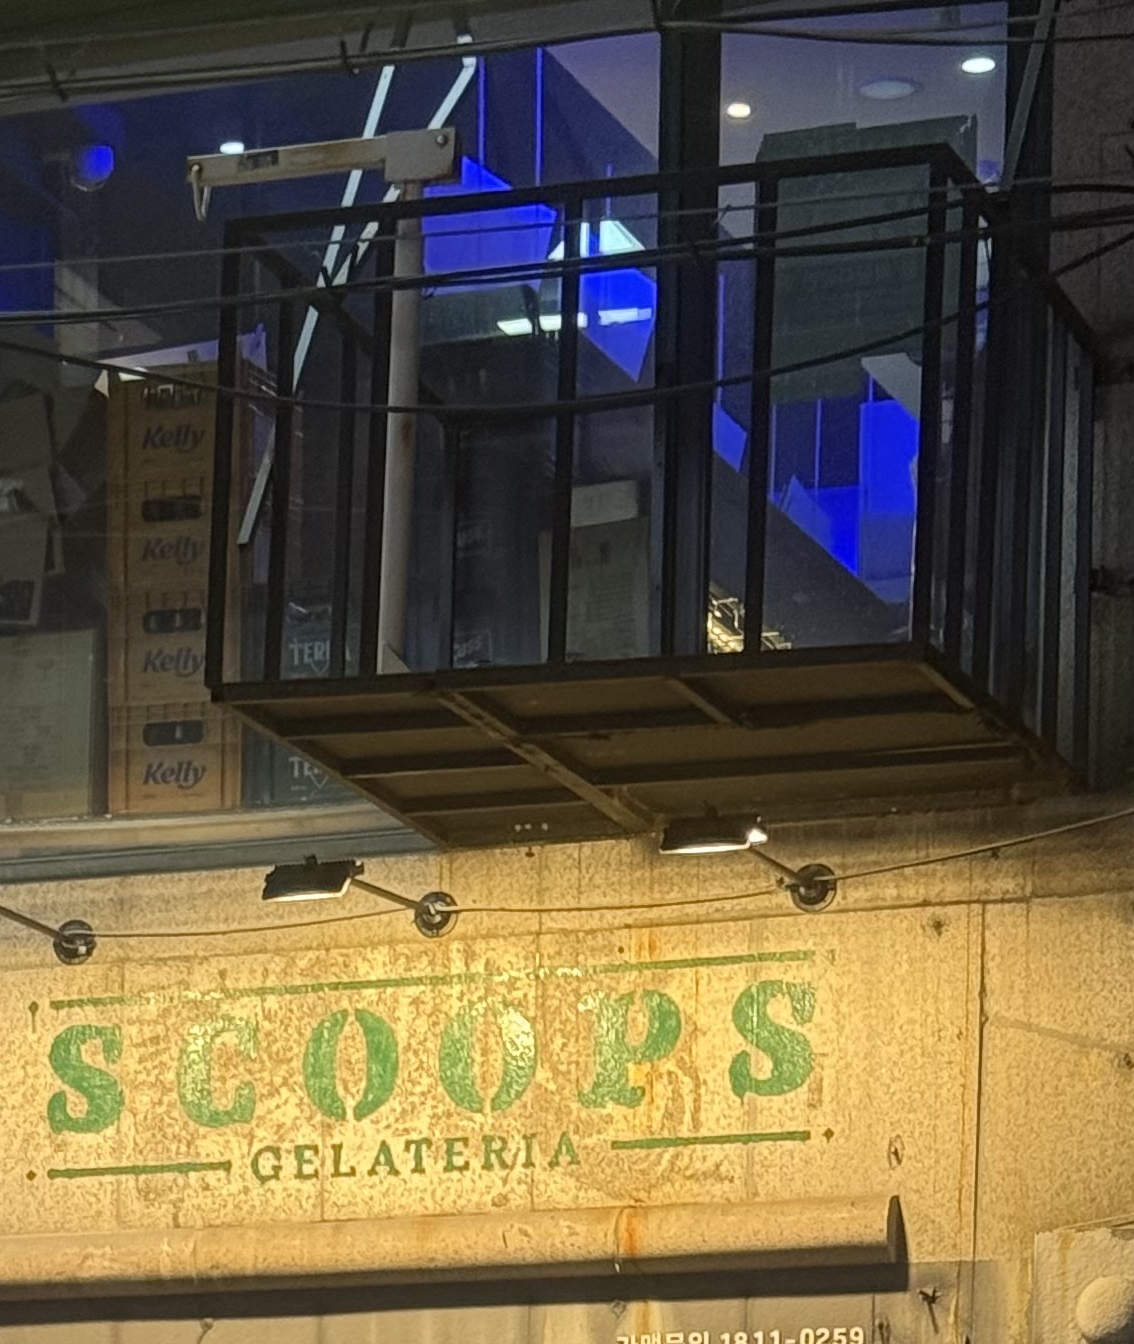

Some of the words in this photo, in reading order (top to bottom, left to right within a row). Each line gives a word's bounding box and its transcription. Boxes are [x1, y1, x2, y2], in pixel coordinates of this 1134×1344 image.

[142, 424, 207, 454] Kelly
[141, 535, 205, 566] Kelly
[143, 647, 205, 679] Kelly
[143, 760, 207, 791] Kelly
[46, 980, 817, 1135] SCOOPS
[251, 1130, 582, 1182] GELATERIA
